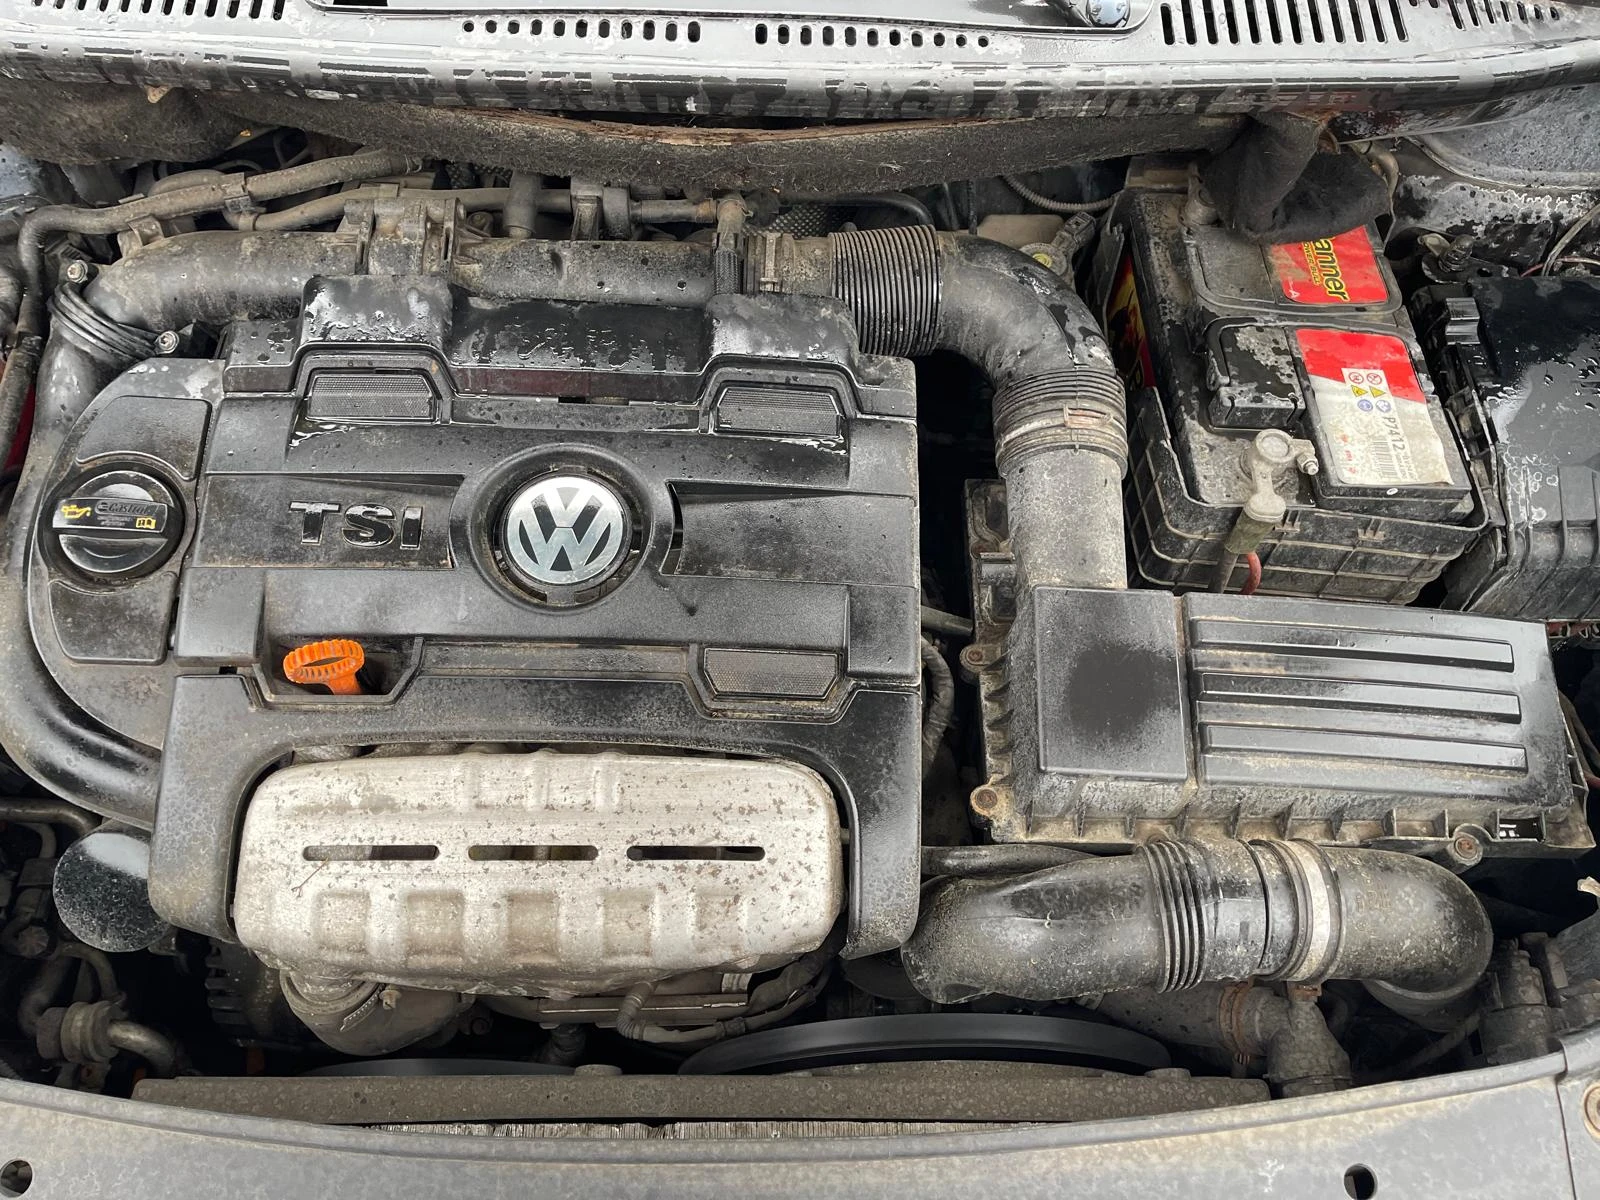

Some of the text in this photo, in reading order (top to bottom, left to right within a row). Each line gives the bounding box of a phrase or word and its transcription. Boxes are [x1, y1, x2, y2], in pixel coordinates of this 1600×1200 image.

[1302, 241, 1316, 264] OWER
[1313, 238, 1350, 301] anner
[289, 501, 424, 550] TSI
